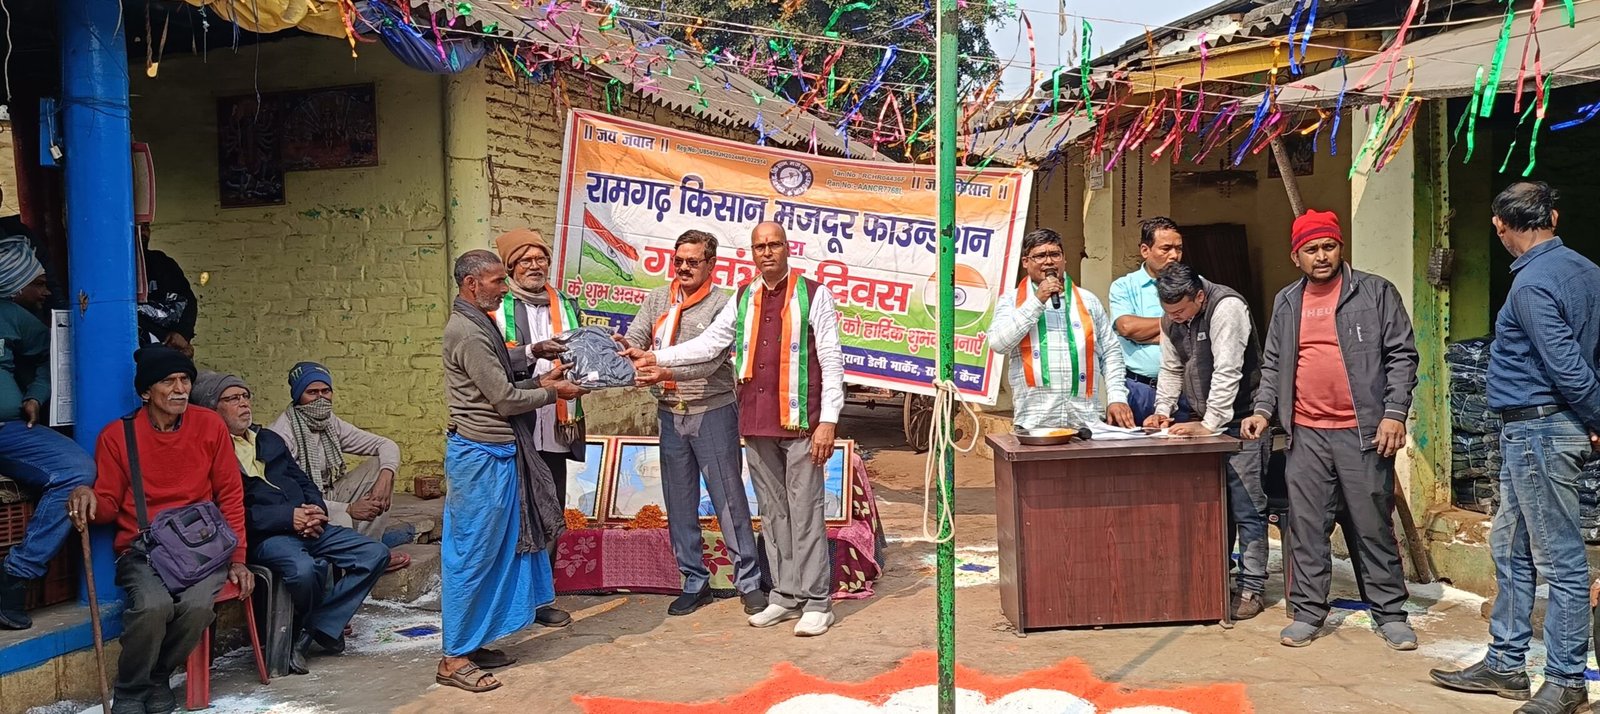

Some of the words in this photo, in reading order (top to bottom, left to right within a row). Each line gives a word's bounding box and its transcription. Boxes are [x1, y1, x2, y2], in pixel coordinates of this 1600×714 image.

[596, 129, 618, 144] जय
[622, 133, 656, 150] जवान
[586, 172, 675, 222] रामगढ़
[680, 174, 769, 225] किसान
[773, 199, 859, 254] मजदूर
[567, 275, 583, 296] के
[585, 283, 610, 306] शुभ
[814, 259, 913, 313] दिवस
[842, 315, 861, 336] को
[863, 317, 906, 342] हार्दिक
